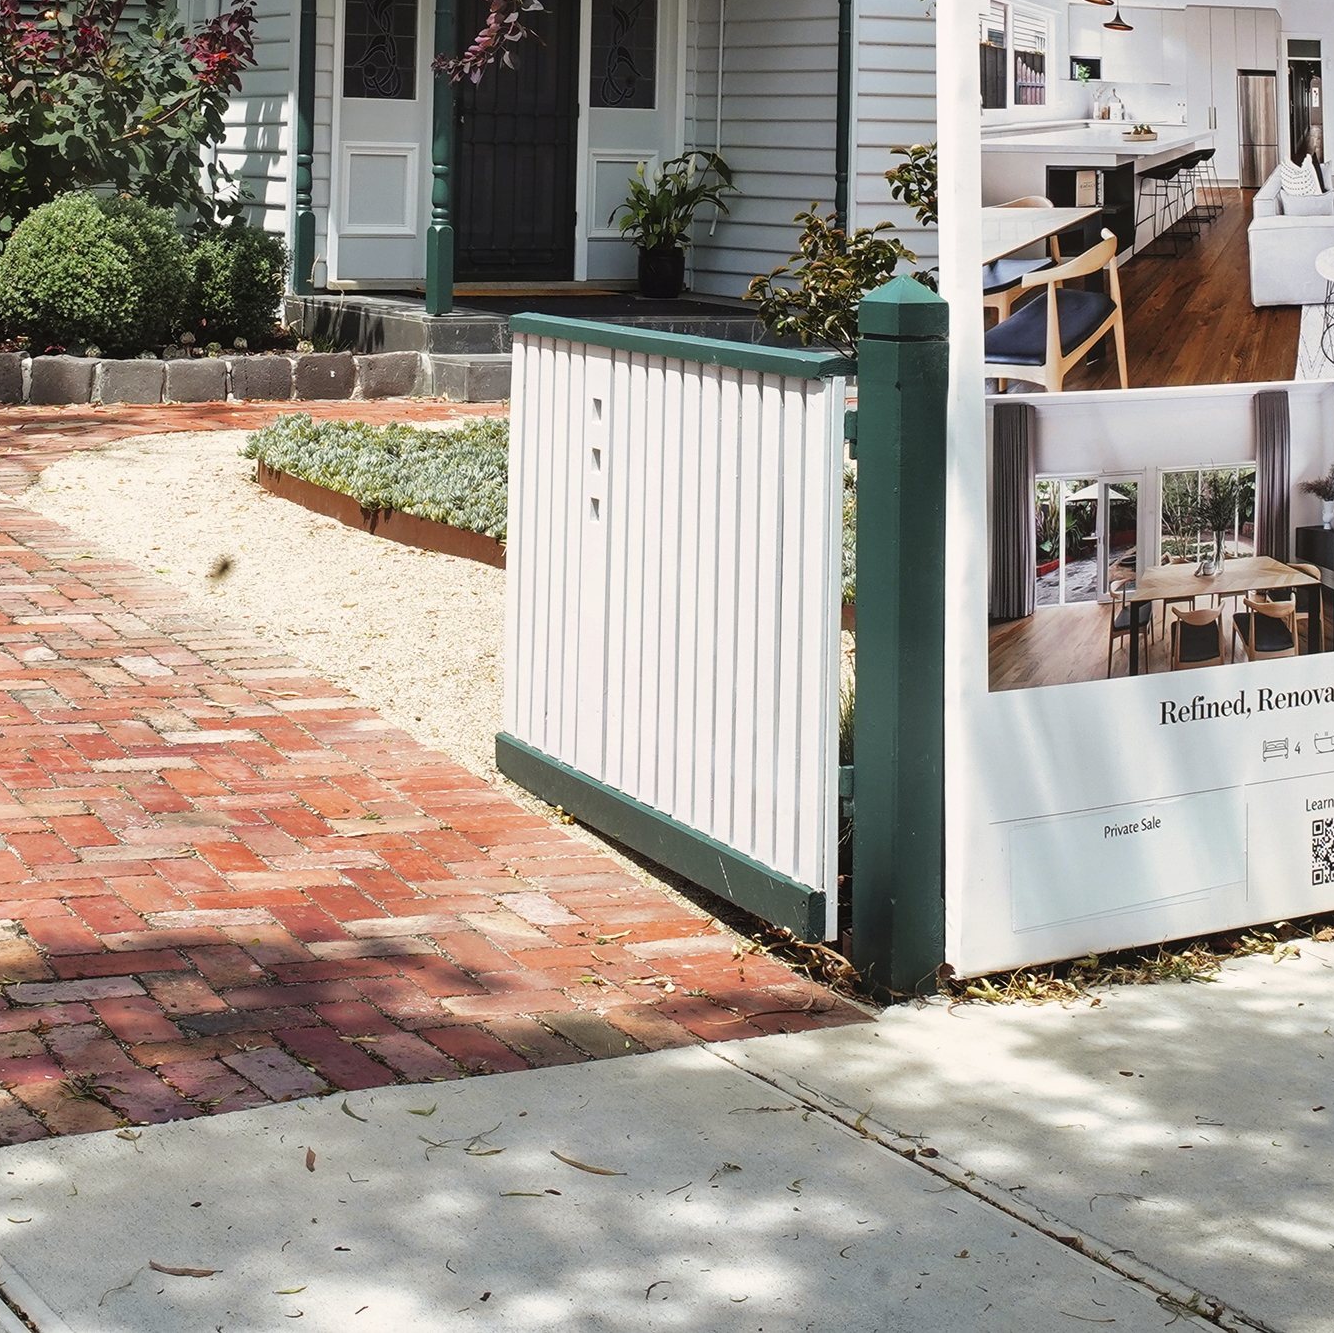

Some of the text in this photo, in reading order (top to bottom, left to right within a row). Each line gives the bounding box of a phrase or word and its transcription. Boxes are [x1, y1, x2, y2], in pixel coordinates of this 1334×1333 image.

[1158, 690, 1252, 725] Refined,
[1294, 741, 1302, 755] 4
[1305, 796, 1334, 812] Learn
[1104, 816, 1161, 838] Private Sale
